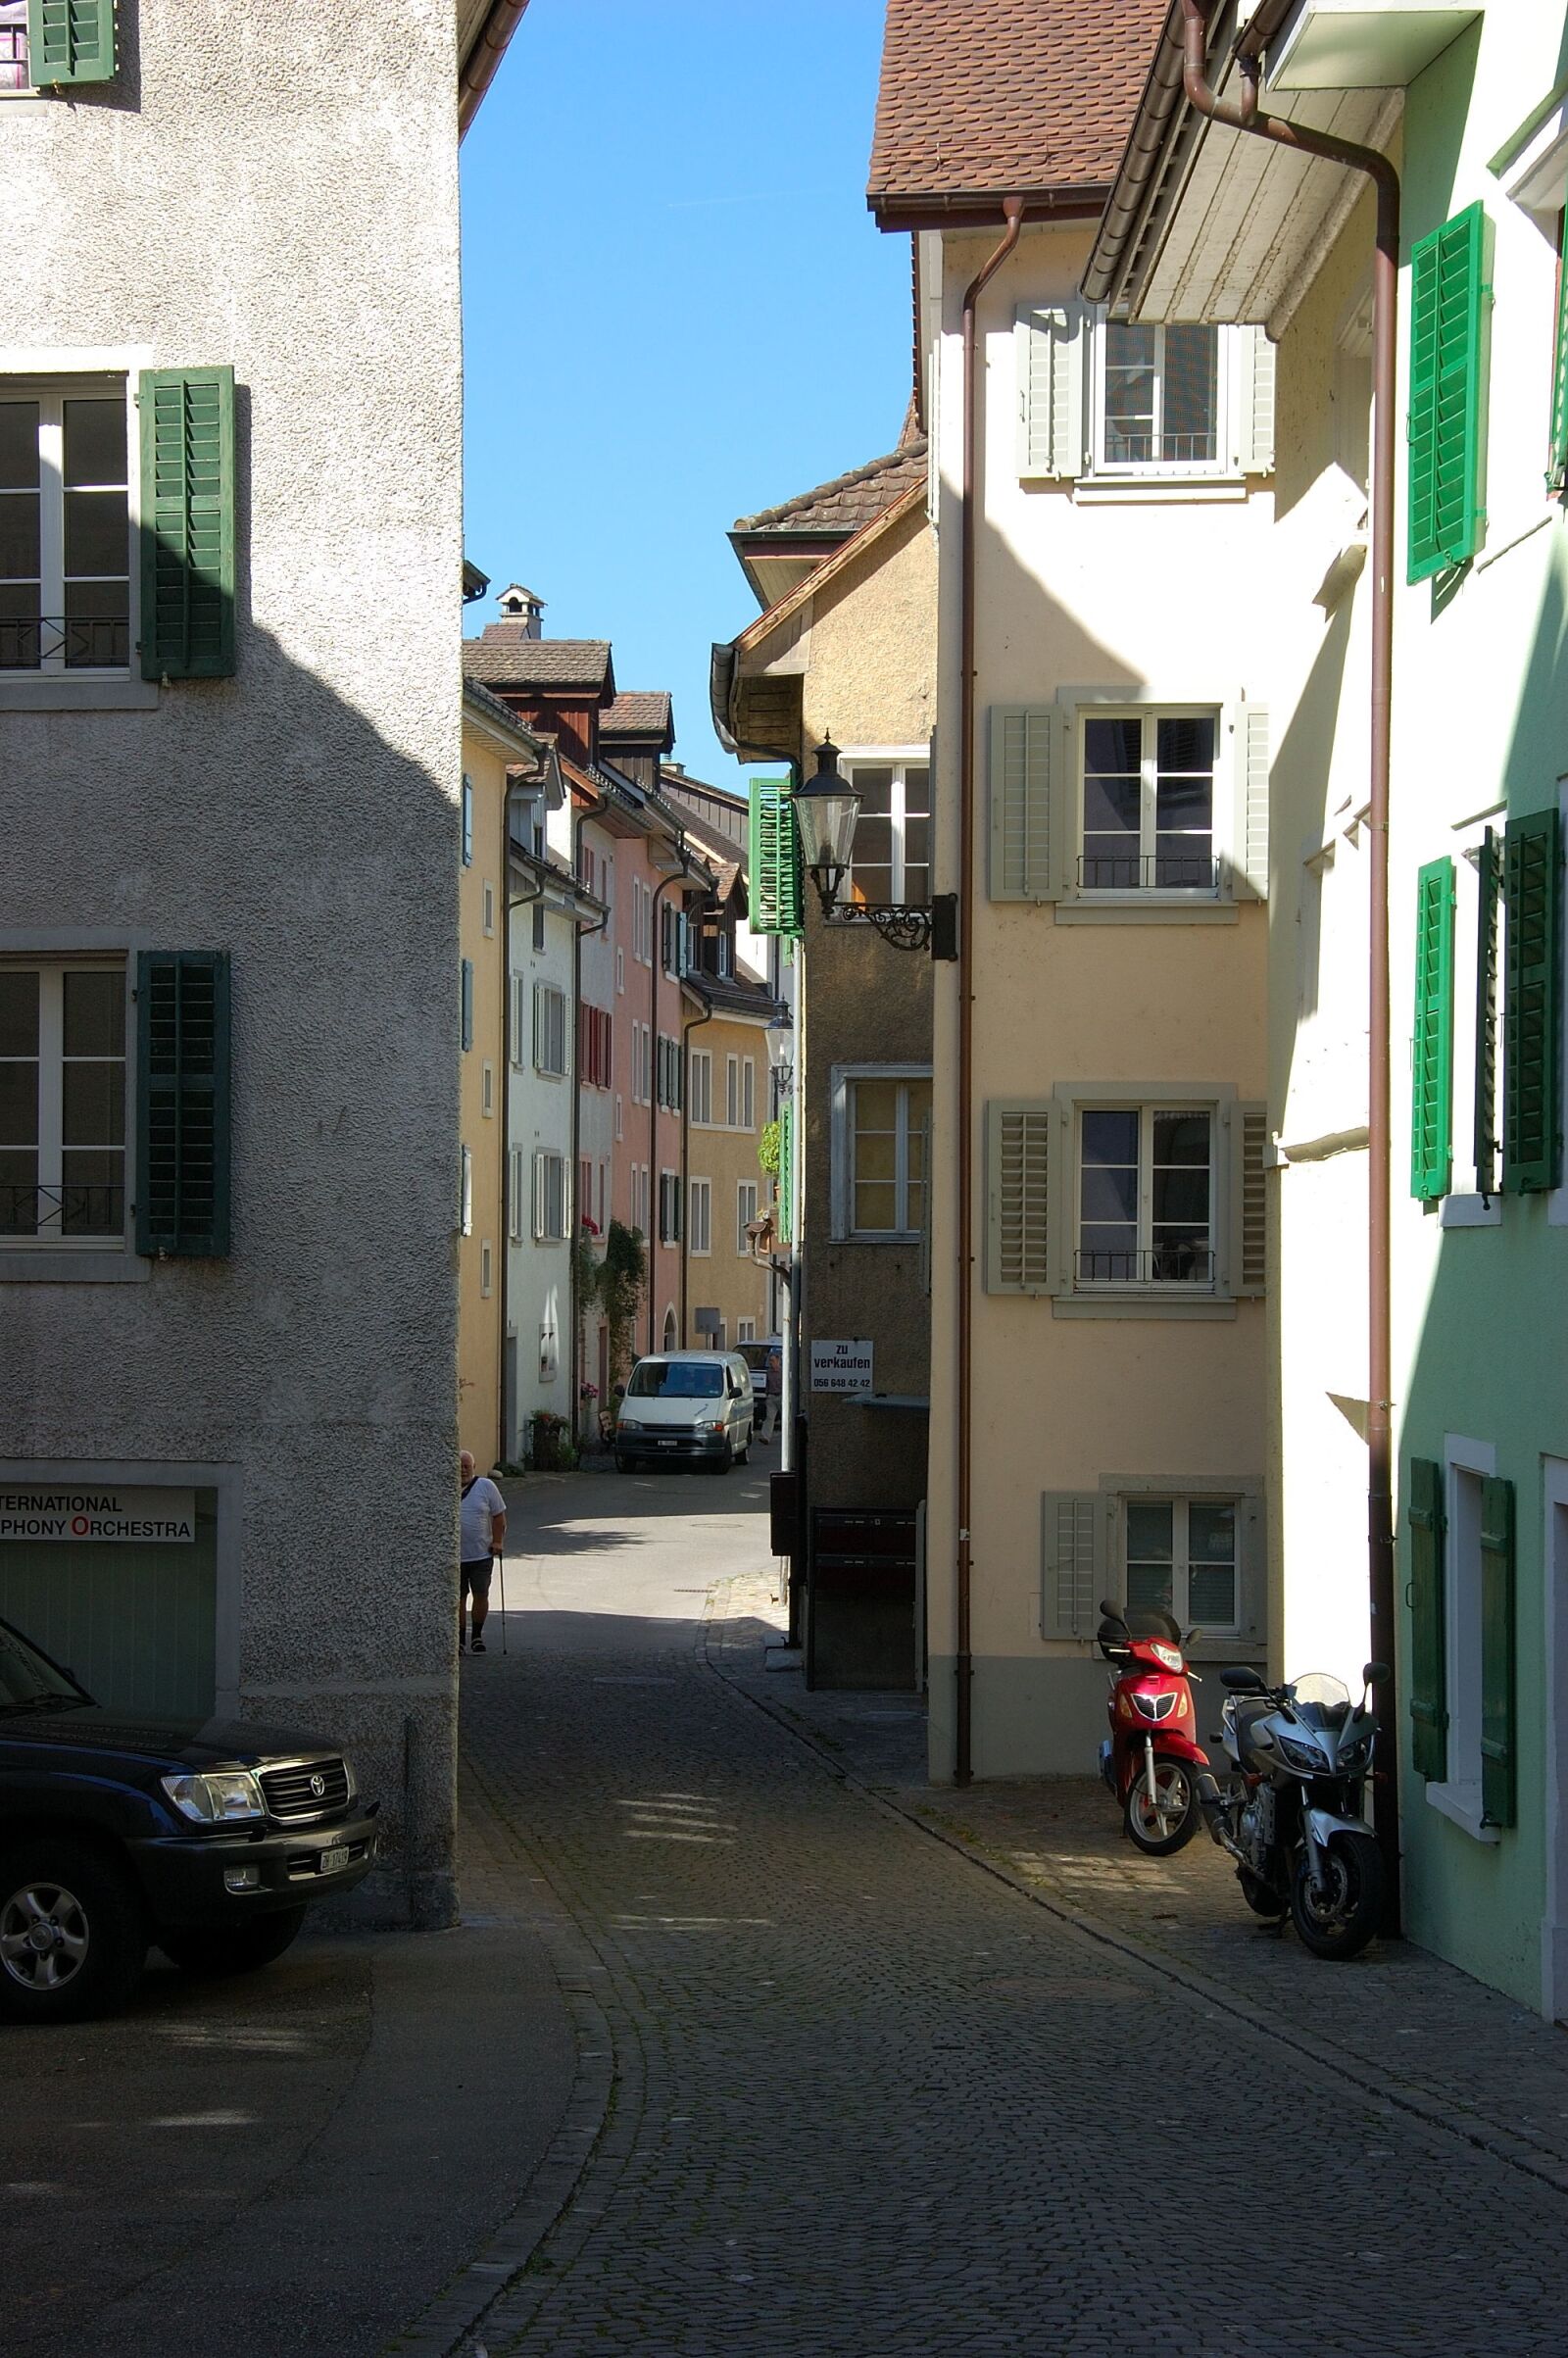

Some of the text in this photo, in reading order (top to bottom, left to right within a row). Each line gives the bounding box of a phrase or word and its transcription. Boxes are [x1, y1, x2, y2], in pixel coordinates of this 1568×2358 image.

[814, 1356, 870, 1369] verkaufen
[814, 1378, 870, 1387] 056 648 42 42
[1, 1516, 190, 1537] PHONY ORCHESTRA
